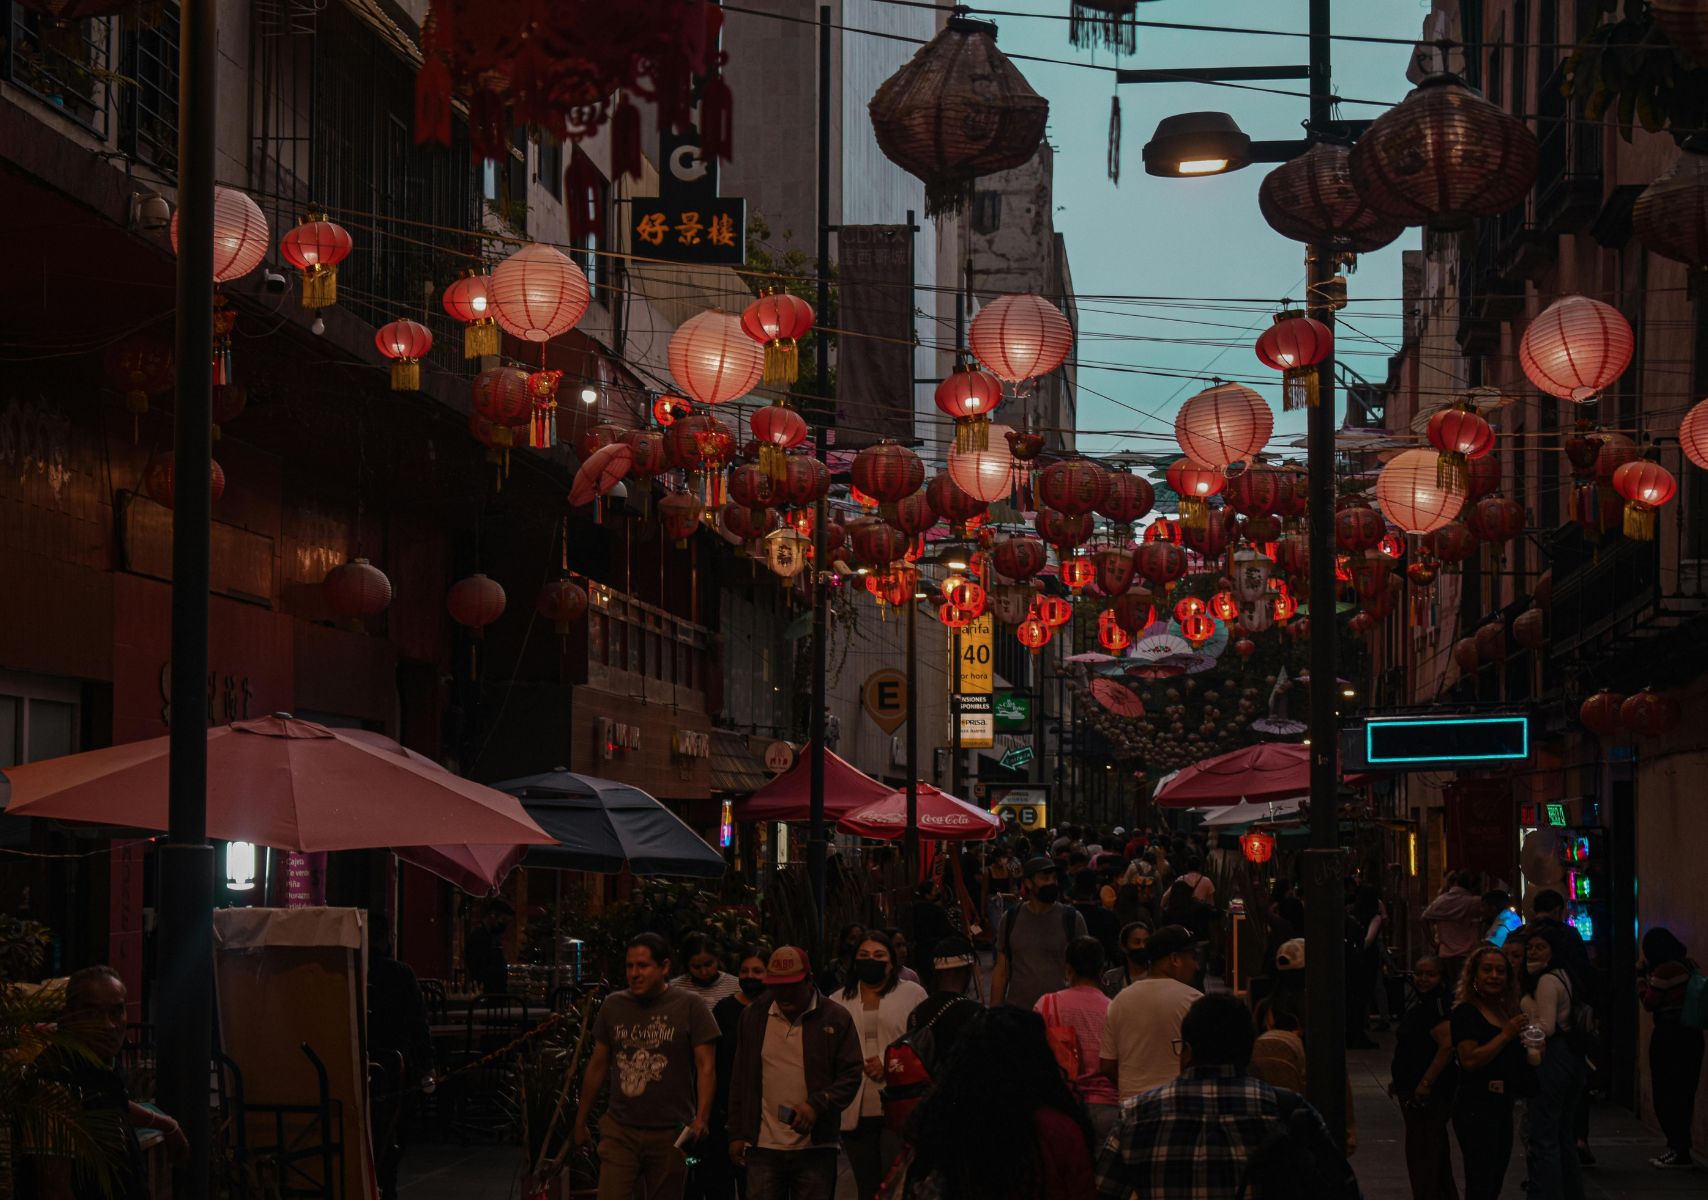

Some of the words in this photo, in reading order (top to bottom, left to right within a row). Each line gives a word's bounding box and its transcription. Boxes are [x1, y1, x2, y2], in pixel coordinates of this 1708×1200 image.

[961, 623, 990, 634] arifa
[961, 644, 990, 665] 40
[970, 671, 988, 680] hora
[879, 682, 899, 710] E
[920, 813, 969, 825] Coca-Cola
[1022, 809, 1034, 824] E
